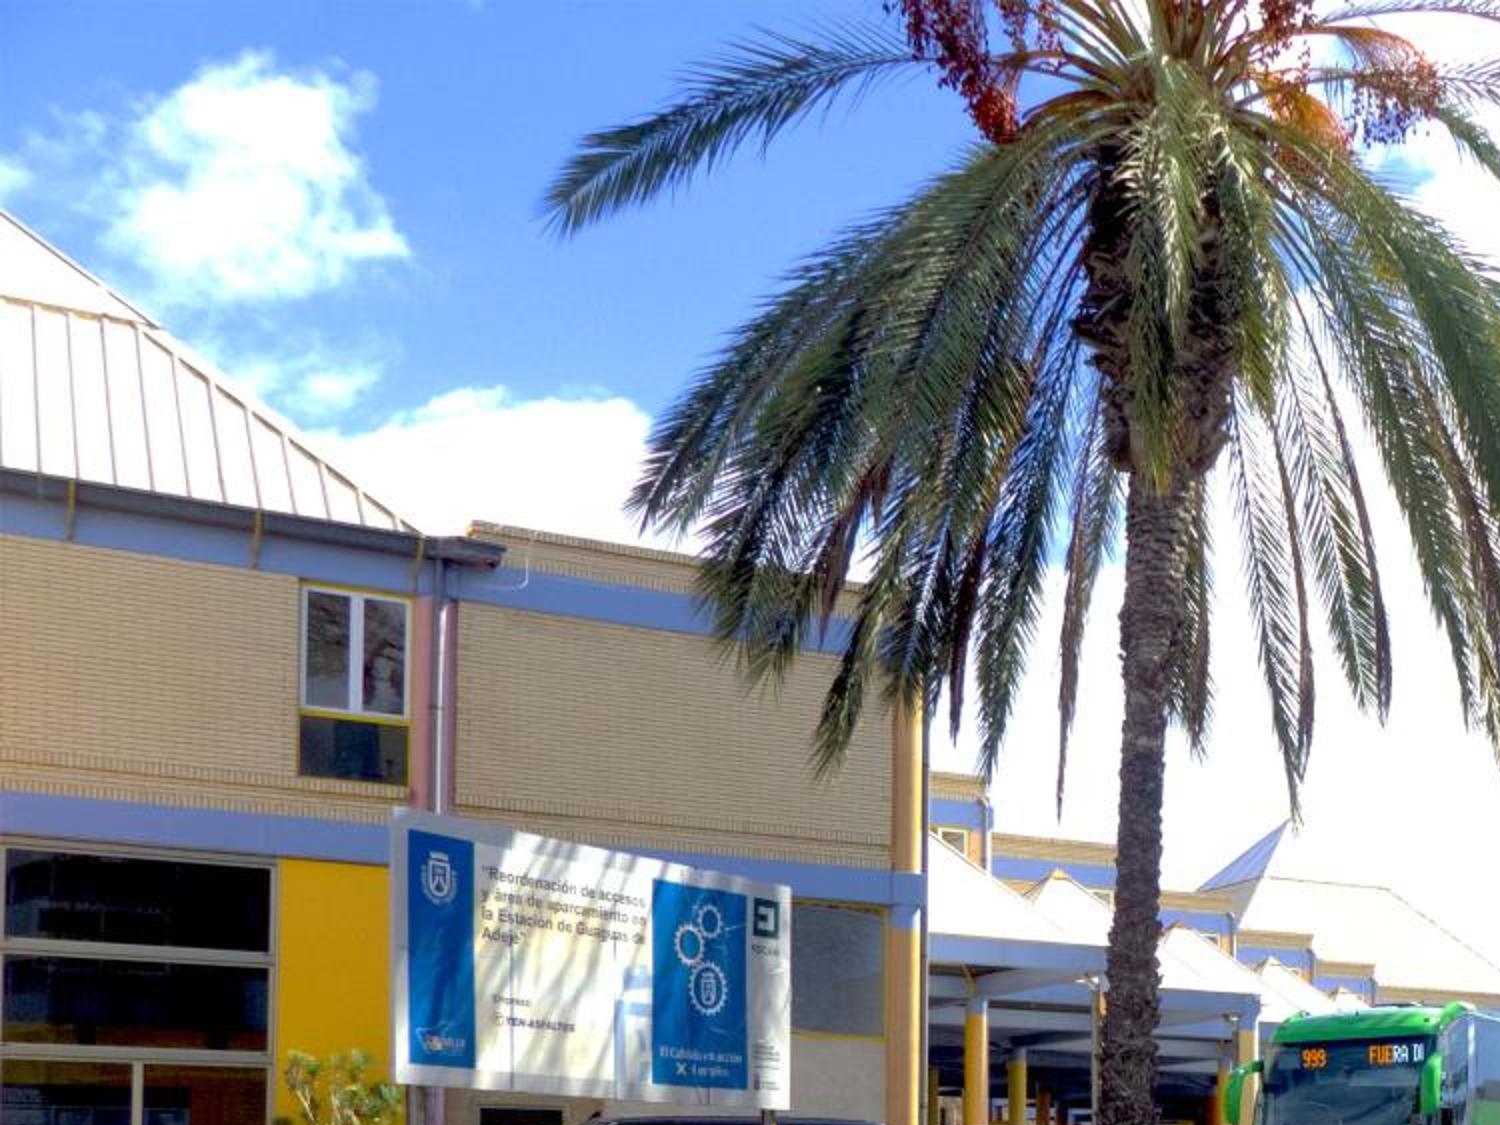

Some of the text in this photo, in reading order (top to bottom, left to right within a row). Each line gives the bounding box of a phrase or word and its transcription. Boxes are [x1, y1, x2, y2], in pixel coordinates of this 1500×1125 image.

[526, 894, 543, 908] de
[580, 886, 596, 899] de
[599, 889, 647, 908] accesos
[481, 905, 493, 920] la
[557, 918, 573, 933] de
[1369, 1044, 1409, 1064] FUERA
